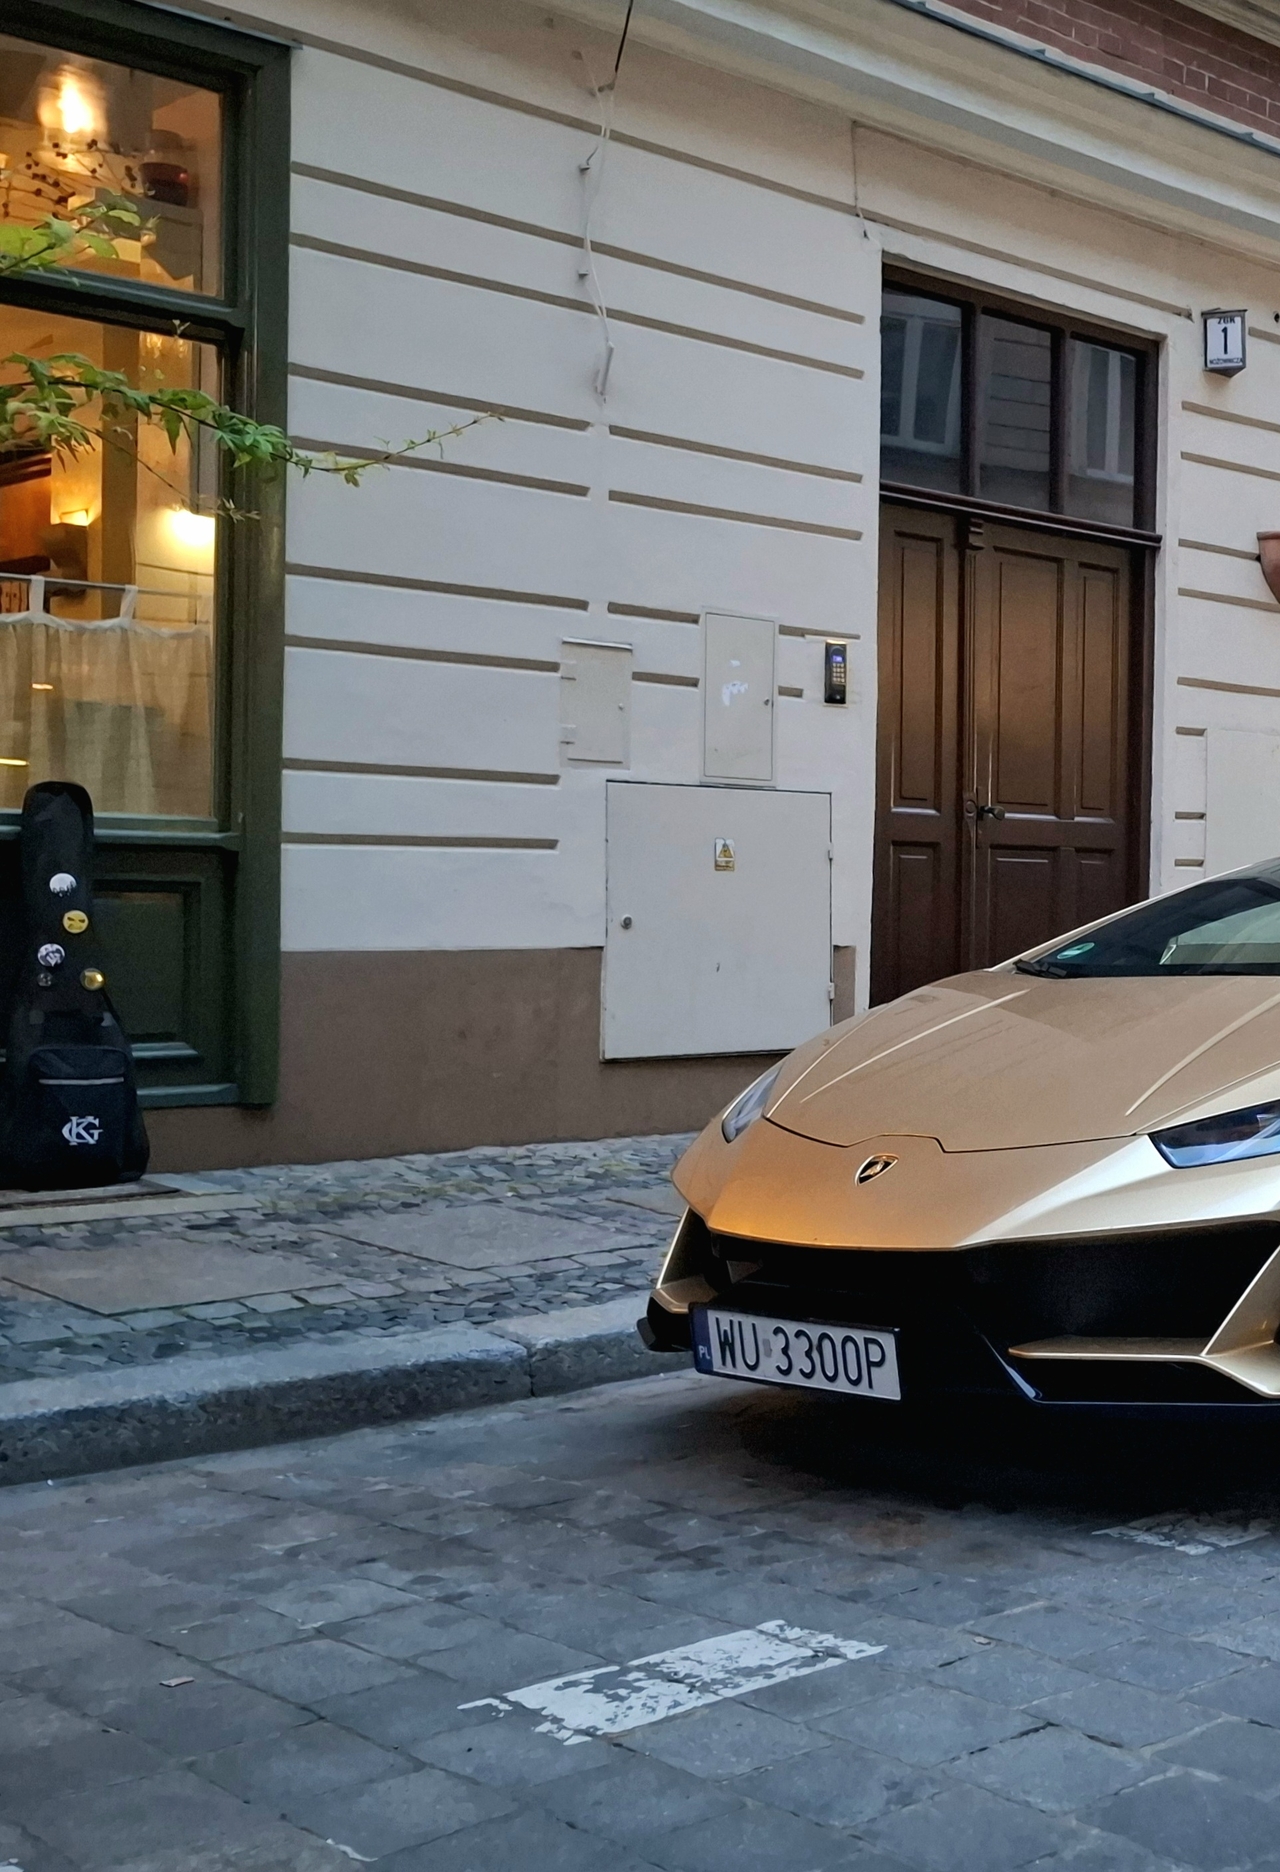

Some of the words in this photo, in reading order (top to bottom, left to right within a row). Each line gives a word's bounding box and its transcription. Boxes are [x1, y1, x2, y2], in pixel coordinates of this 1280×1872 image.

[1221, 326, 1229, 355] 1
[699, 1344, 711, 1360] PL
[715, 1316, 760, 1372] WU
[772, 1325, 886, 1390] 3300P
